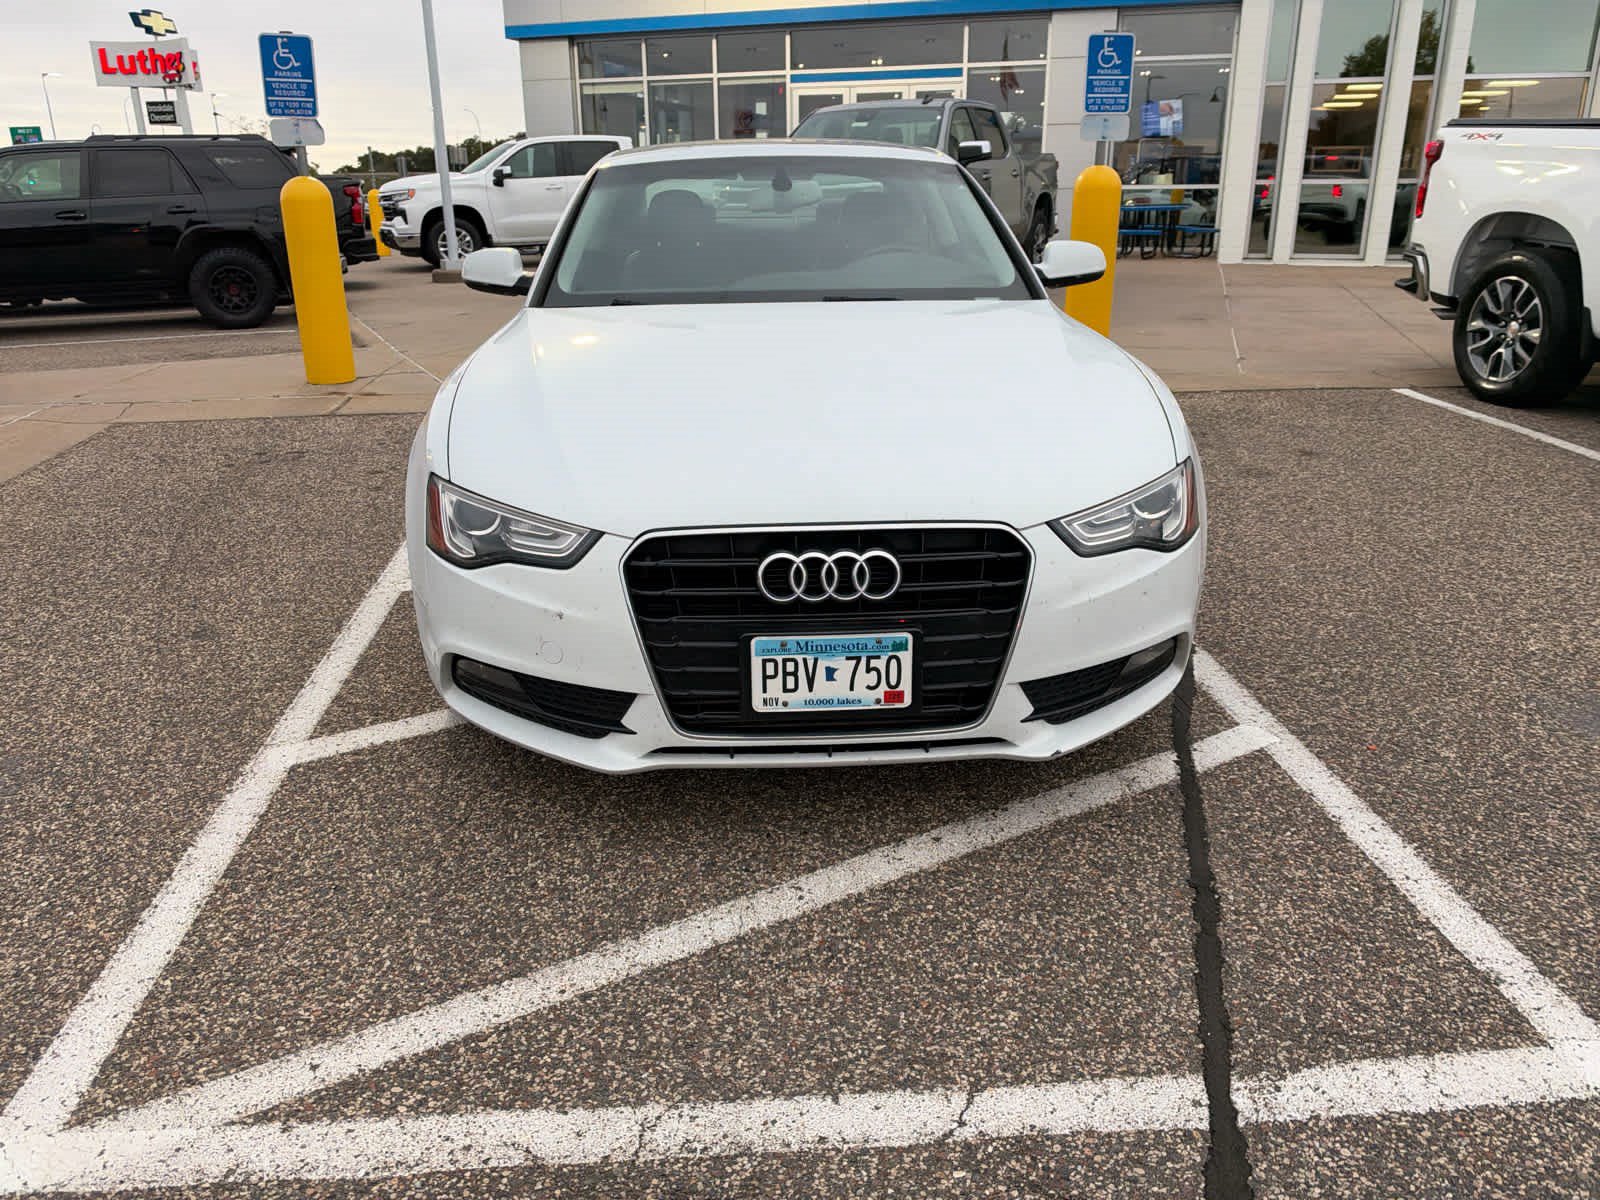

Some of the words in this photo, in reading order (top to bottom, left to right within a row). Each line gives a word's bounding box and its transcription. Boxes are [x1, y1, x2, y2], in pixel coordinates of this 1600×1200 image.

[98, 47, 183, 75] Luther
[795, 639, 890, 652] Minnesota.com
[761, 656, 819, 694] PBV
[845, 655, 902, 692] 750
[762, 697, 780, 707] NOV
[837, 697, 862, 705] lakes
